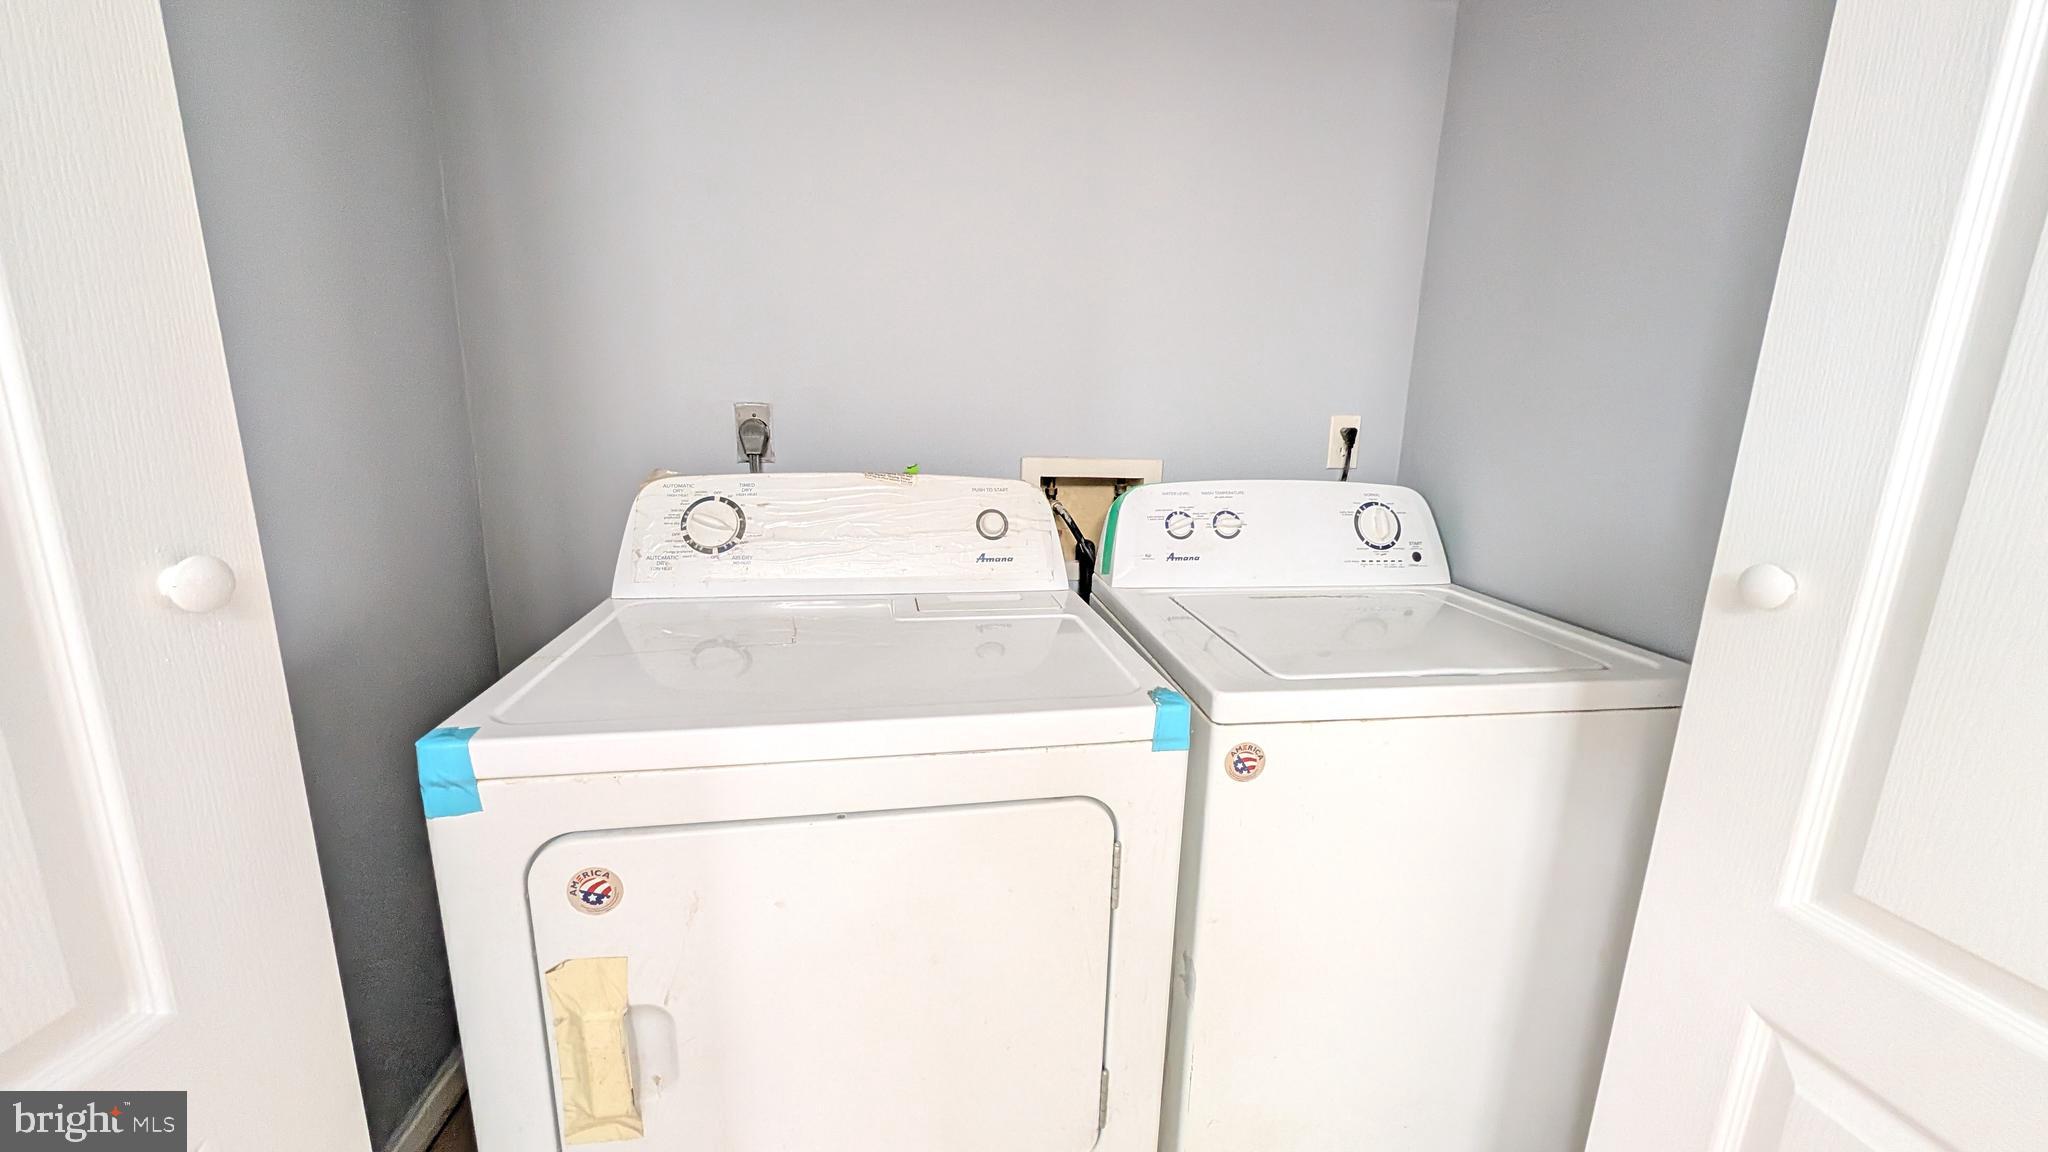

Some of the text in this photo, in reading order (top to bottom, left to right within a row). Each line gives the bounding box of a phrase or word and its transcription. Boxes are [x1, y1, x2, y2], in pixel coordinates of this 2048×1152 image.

[976, 553, 1014, 563] Amana
[1166, 552, 1200, 562] Amana
[1231, 745, 1264, 761] AMERICA
[570, 870, 610, 897] AMERICA
